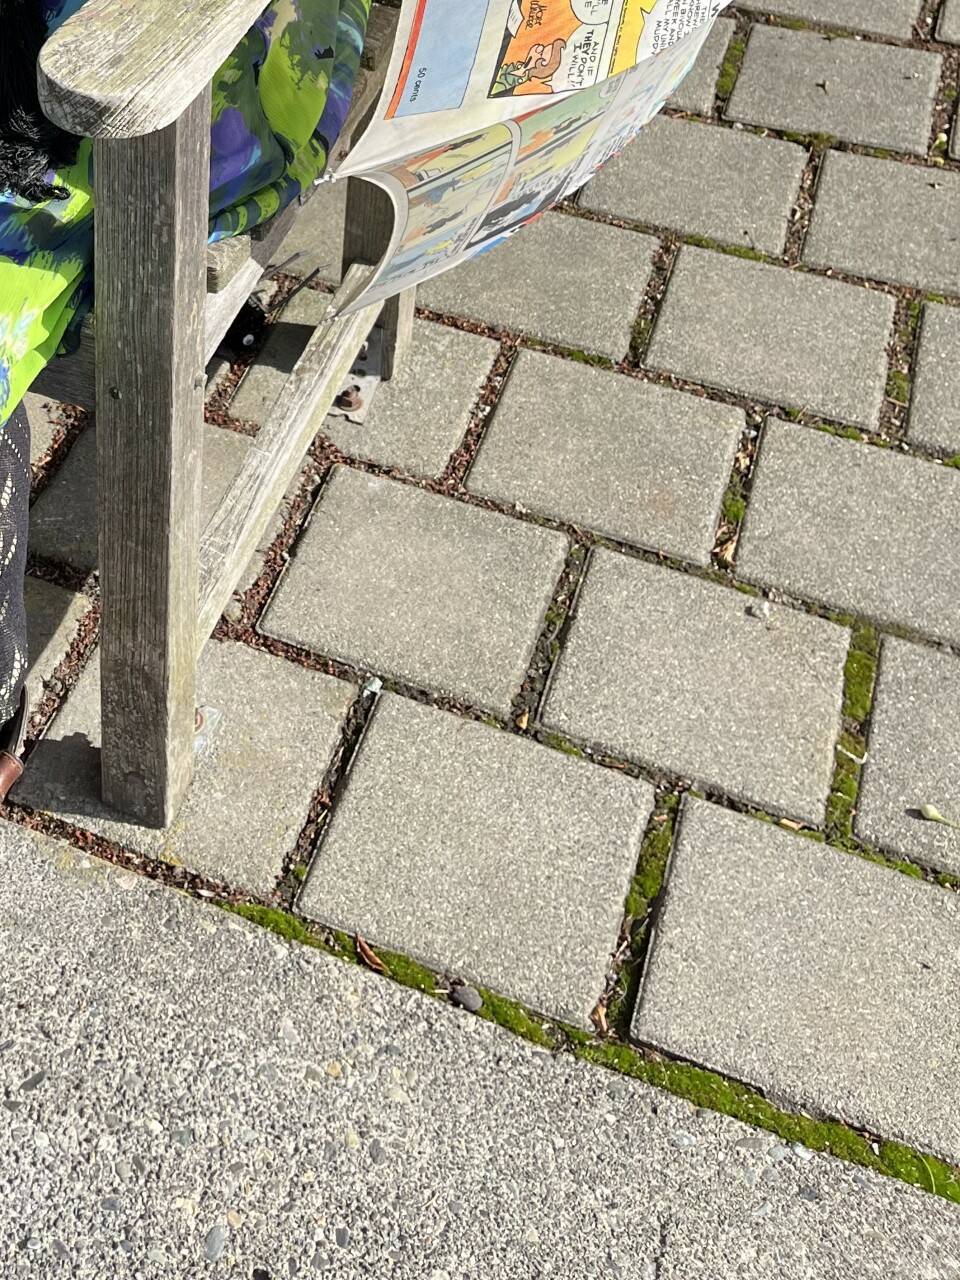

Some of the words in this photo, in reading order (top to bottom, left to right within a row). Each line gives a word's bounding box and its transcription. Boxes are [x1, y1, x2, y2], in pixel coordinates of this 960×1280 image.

[662, 18, 670, 33] MY
[573, 43, 583, 51] I
[580, 29, 595, 55] THEY
[588, 40, 600, 64] AND
[417, 67, 427, 78] 50
[575, 57, 589, 87] DON'T
[586, 66, 595, 77] IF
[409, 80, 423, 103] cents
